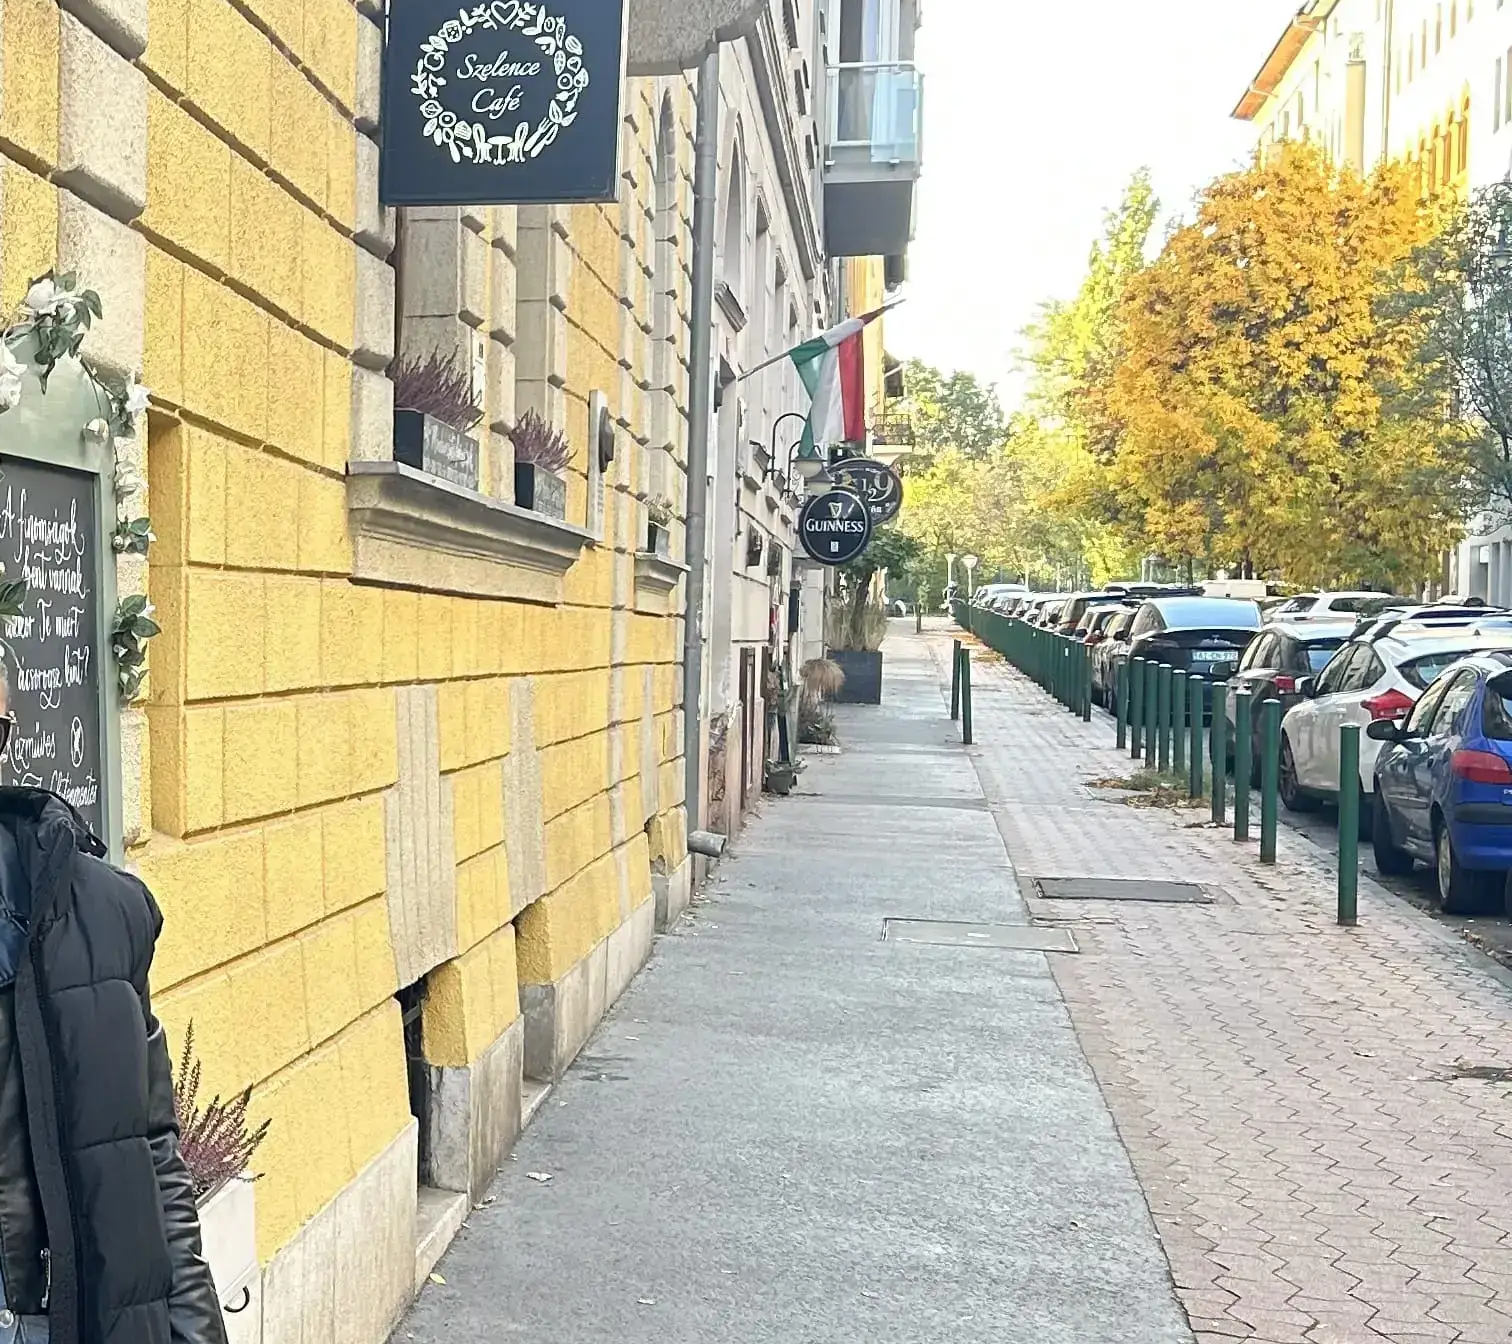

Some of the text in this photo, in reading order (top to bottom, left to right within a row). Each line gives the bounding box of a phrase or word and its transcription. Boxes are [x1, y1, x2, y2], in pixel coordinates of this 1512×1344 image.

[456, 50, 541, 82] Szelence
[471, 85, 524, 120] Café
[805, 518, 864, 533] GUINNESS
